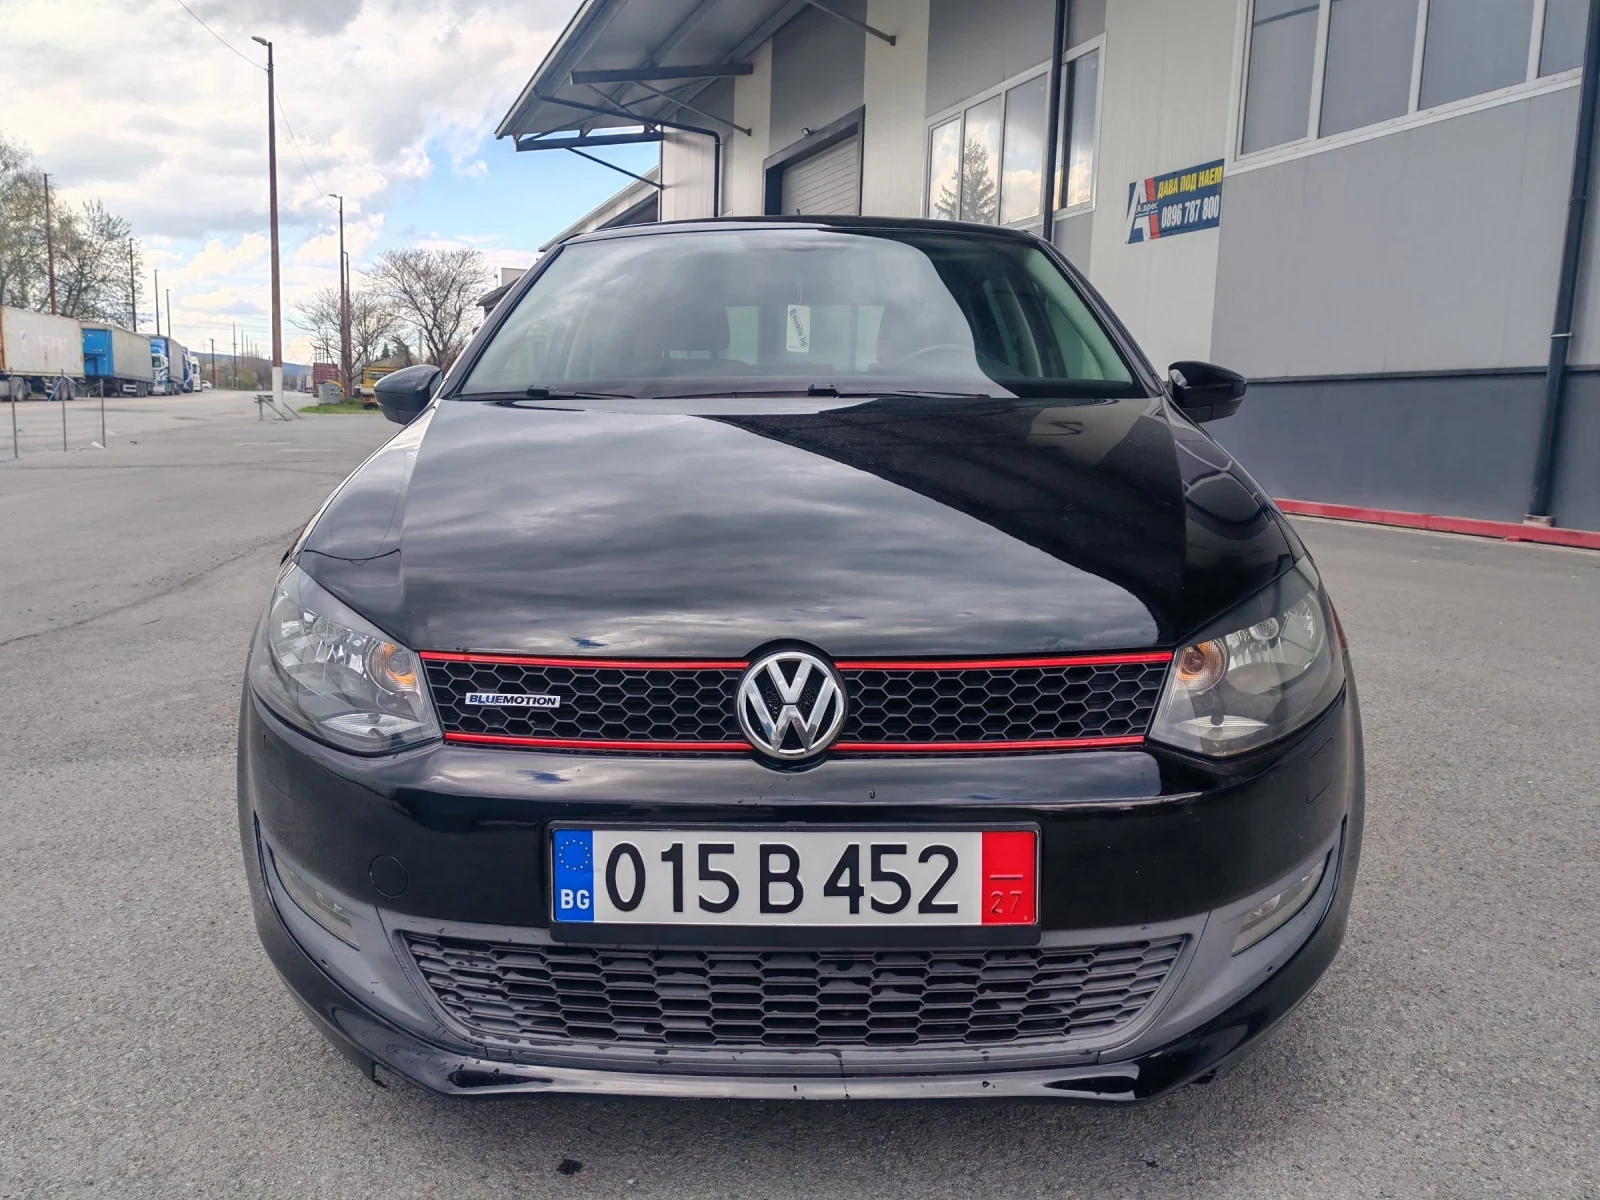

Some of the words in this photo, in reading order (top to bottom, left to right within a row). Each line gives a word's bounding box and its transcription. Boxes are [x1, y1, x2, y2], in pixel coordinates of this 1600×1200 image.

[1157, 178, 1178, 199] ДАВА
[1180, 173, 1197, 192] ПОД
[1198, 166, 1223, 188] НАЕМ
[1161, 203, 1182, 228] 0896
[1202, 194, 1220, 220] 800
[469, 694, 557, 706] BLUEMOTION
[560, 888, 590, 910] BG
[991, 890, 1023, 914] 27
